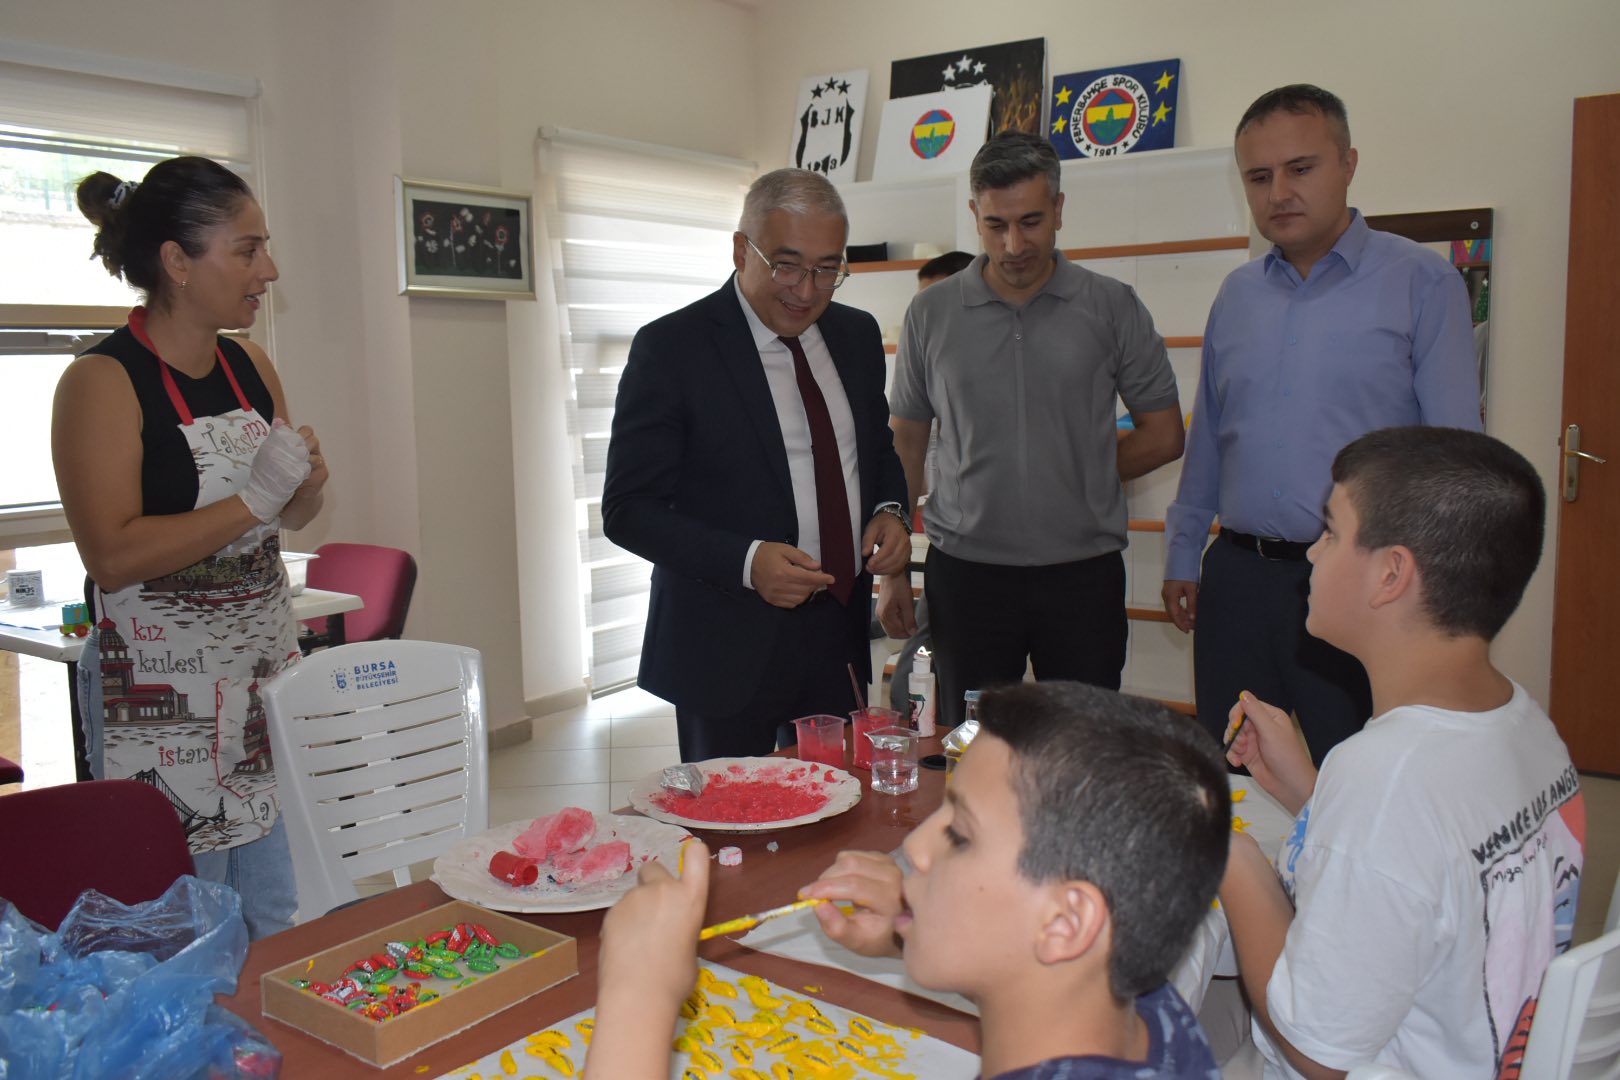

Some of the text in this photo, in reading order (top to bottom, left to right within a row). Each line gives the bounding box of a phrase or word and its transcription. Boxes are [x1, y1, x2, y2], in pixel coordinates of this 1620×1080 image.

[1112, 77, 1139, 94] SPOR
[137, 649, 208, 674] kulesi
[353, 660, 396, 675] BURSA
[1471, 804, 1531, 865] VENICE
